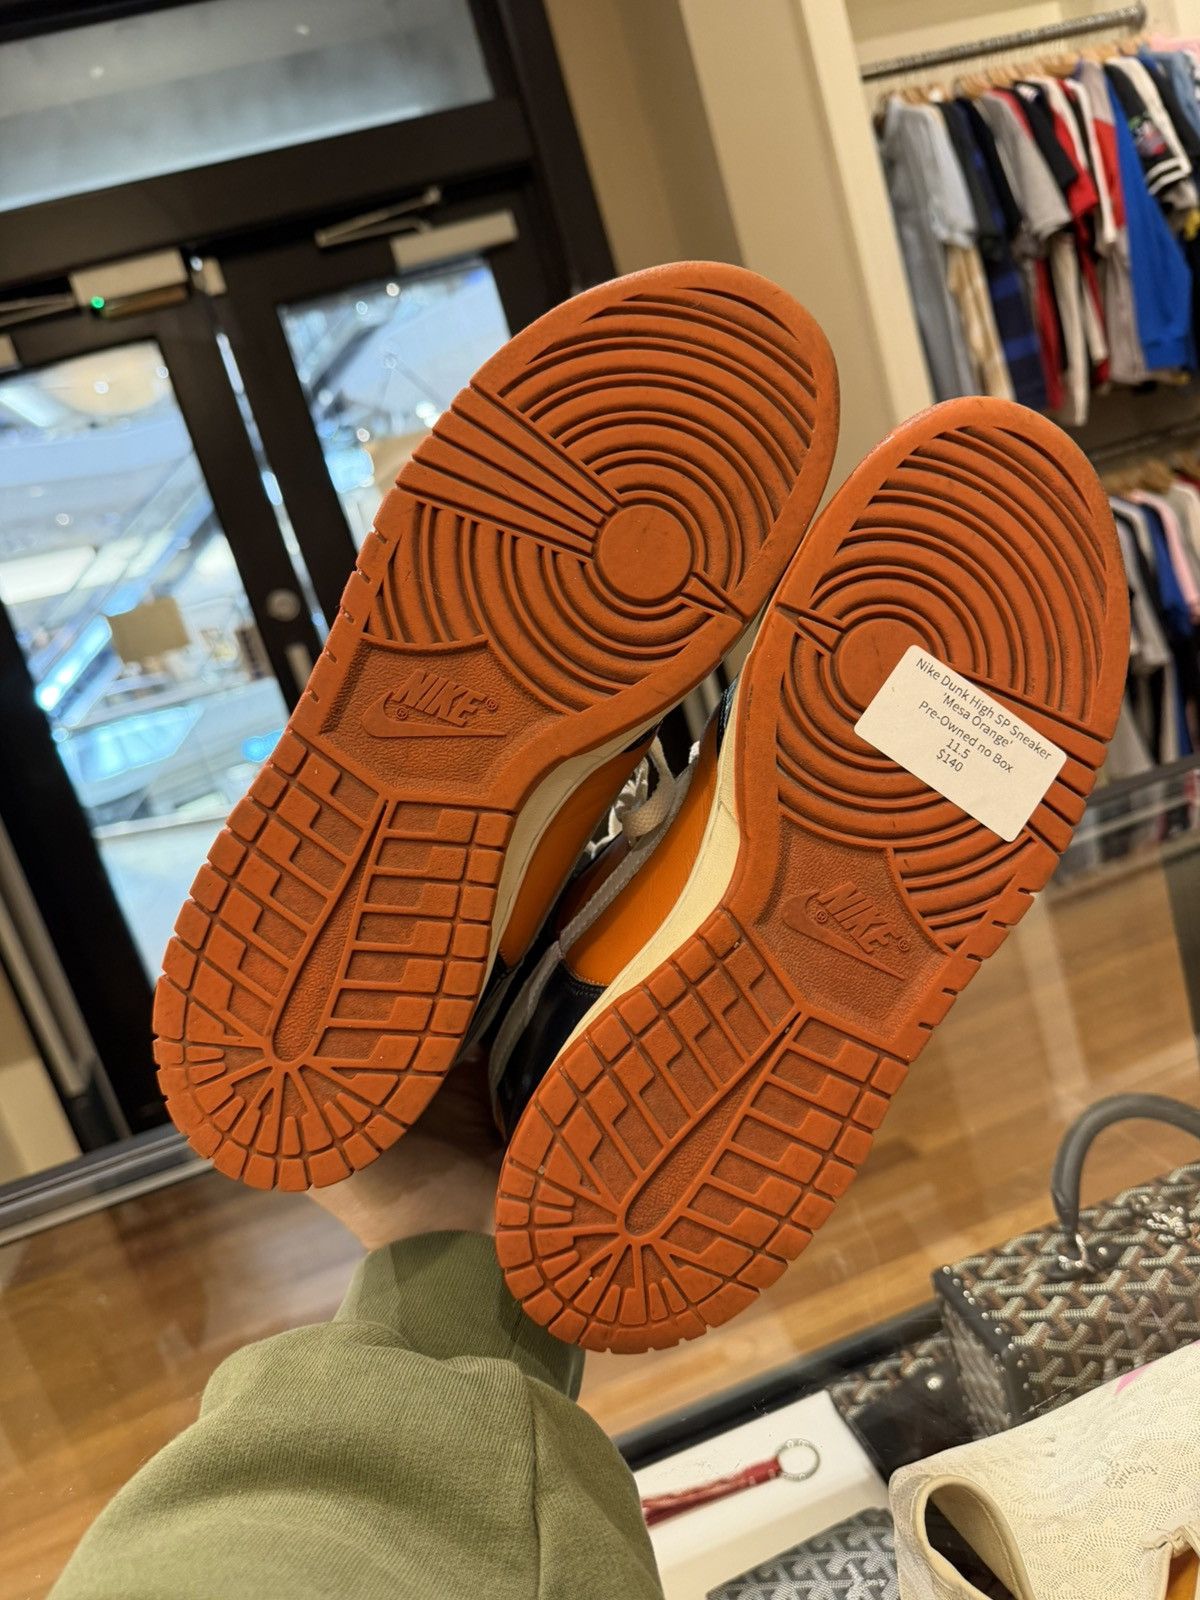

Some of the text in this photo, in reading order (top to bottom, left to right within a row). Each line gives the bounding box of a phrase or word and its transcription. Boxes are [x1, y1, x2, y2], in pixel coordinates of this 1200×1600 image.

[391, 669, 487, 727] NIKE
[916, 658, 1052, 760] Nike Dunk High SP Sneaker
[918, 701, 1014, 773] Pre-Owned no Box
[936, 749, 963, 771] $140
[946, 738, 970, 759] 11.5
[816, 881, 901, 954] NIKE
